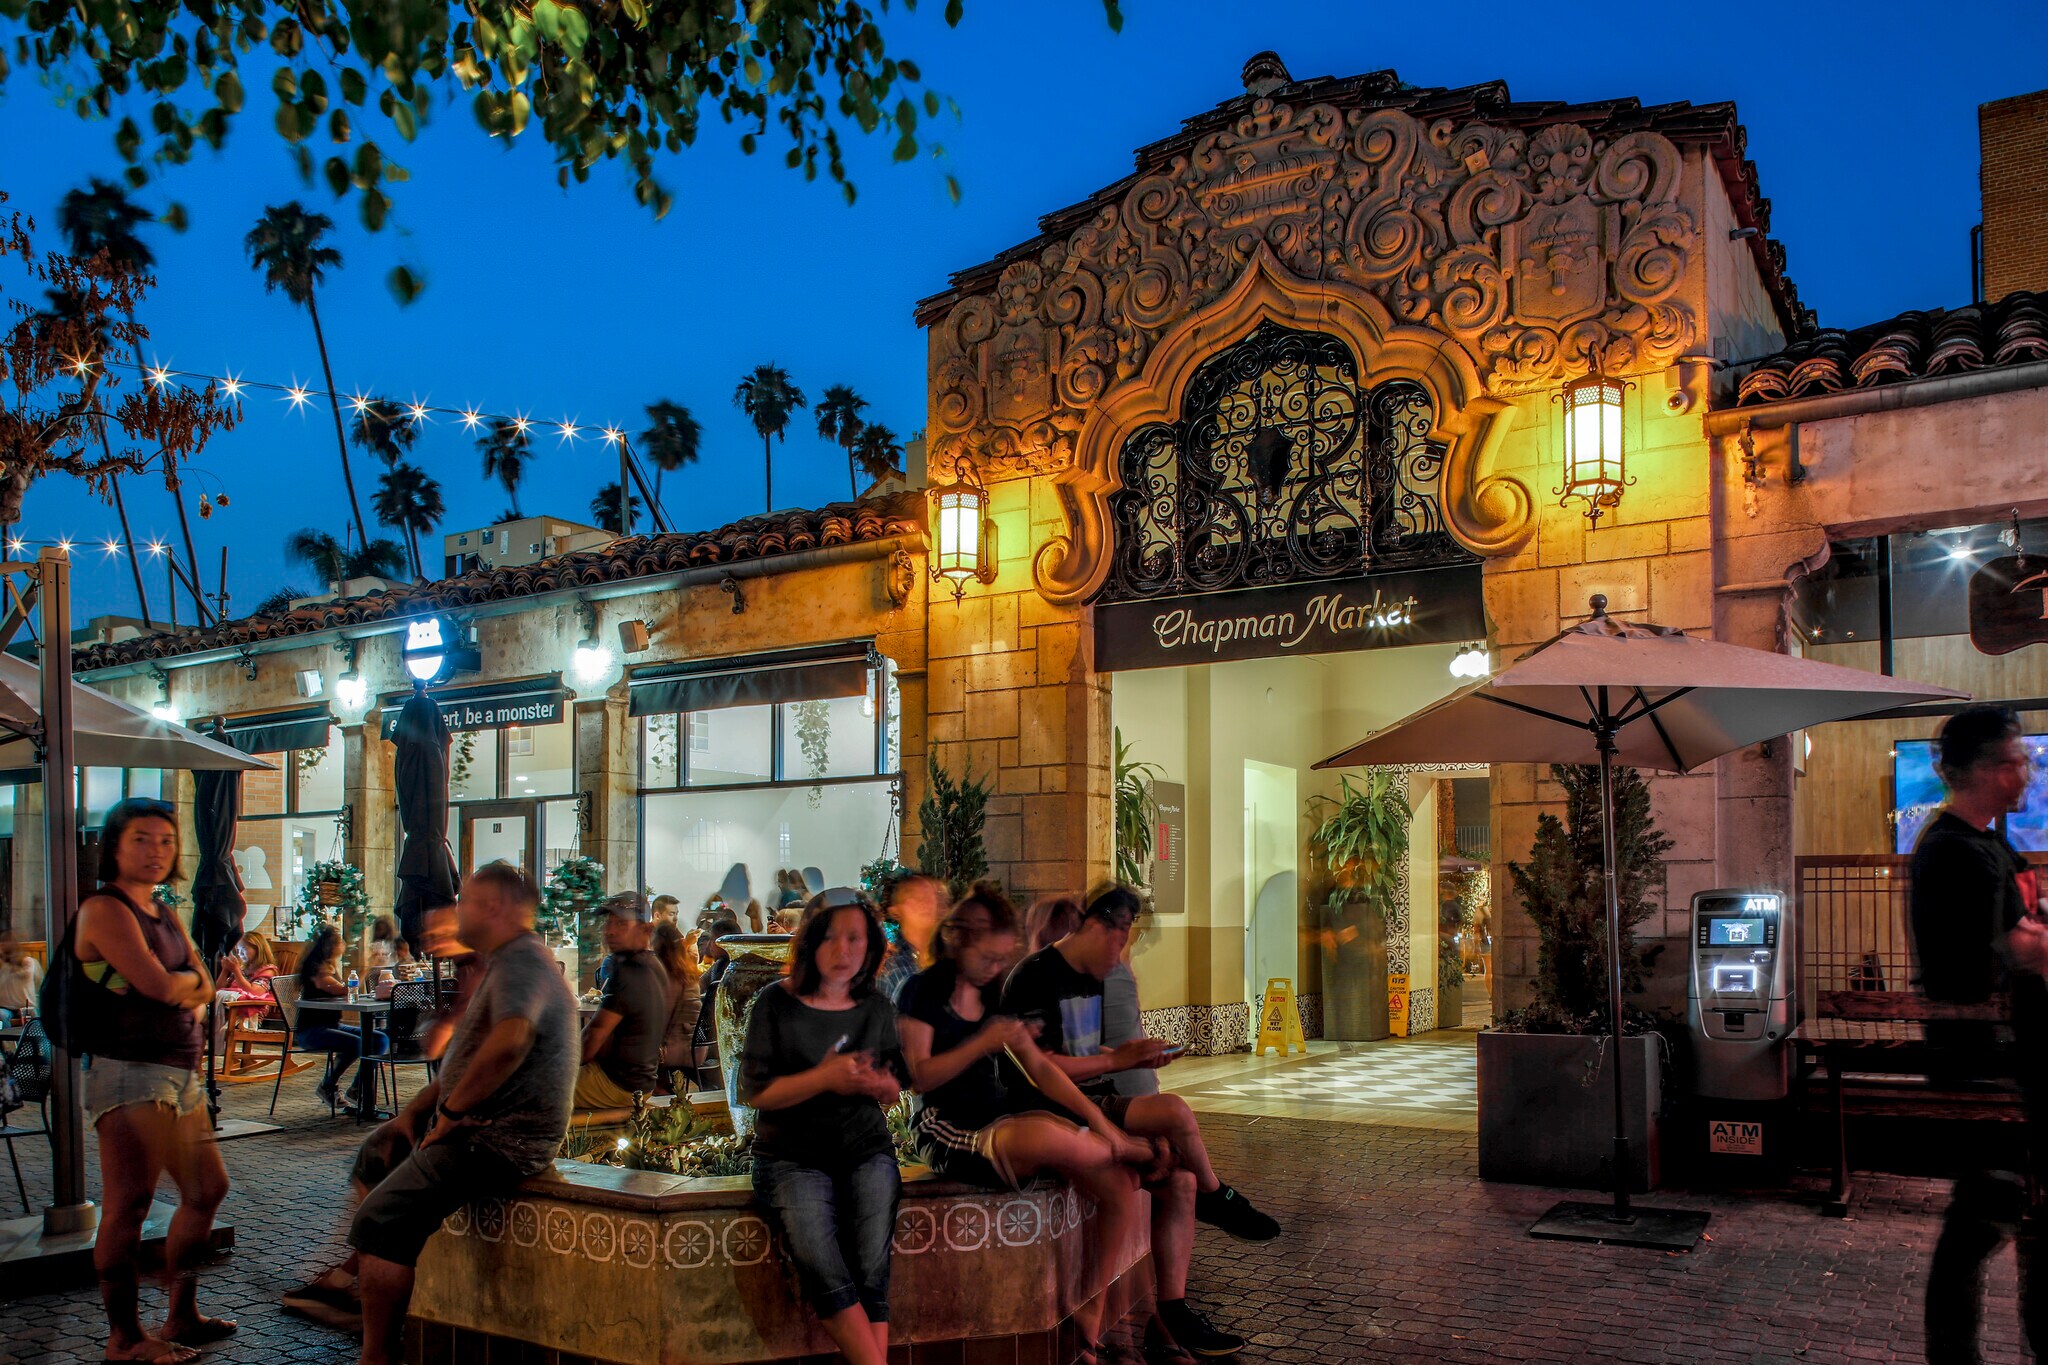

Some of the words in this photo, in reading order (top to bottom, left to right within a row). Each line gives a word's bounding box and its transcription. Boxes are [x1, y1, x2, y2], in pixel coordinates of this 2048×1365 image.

[1152, 608, 1294, 653] Chapman
[1279, 589, 1419, 648] Market
[465, 707, 482, 725] be
[485, 710, 494, 724] a
[497, 702, 555, 721] monster
[1745, 899, 1776, 911] ATM
[1713, 1123, 1759, 1137] ATM
[1716, 1135, 1755, 1145] INSIDE
